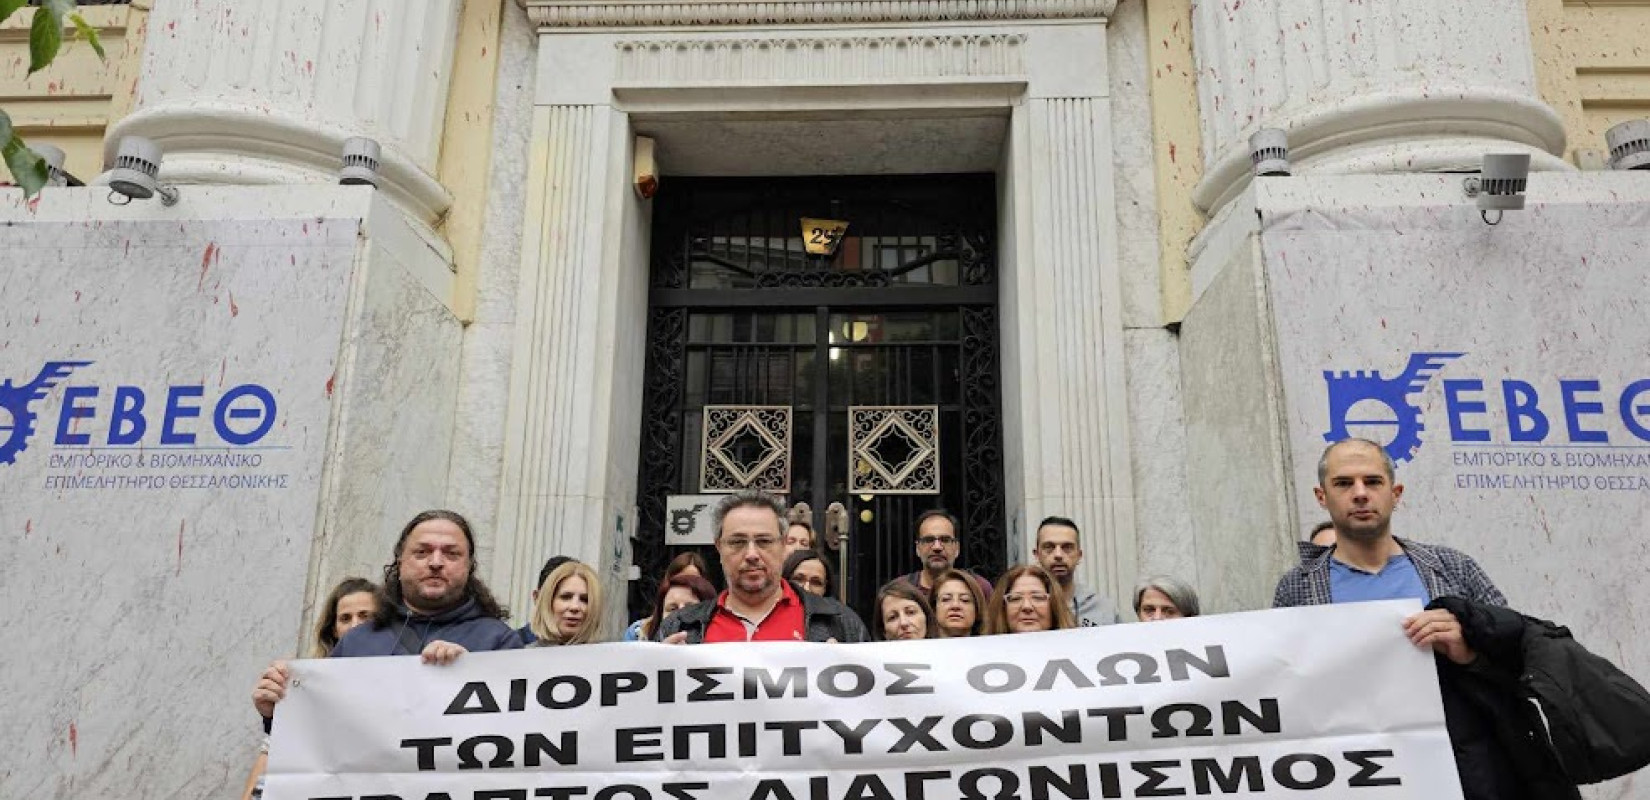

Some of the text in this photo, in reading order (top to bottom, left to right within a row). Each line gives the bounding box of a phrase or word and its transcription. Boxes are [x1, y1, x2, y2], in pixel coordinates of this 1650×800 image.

[54, 384, 277, 445] ΕΒΕΘ
[49, 454, 262, 468] ΕΜΠΟΡΙΚΟ & ΒΙΟΜΗΧΑΝΙΚΟ
[1453, 452, 1650, 468] ΕΜΠΟΡΙΚΟ & ΒΙΟΜΗΧΑ
[45, 474, 288, 489] ΕΠΙΜΕΛΗΤΗΡΙΟ ΘΕΣΣΑΛΟΝΙΚΗΣ
[1455, 474, 1590, 490] ΕΠΙΜΕΛΗΤΗΡΙΟ
[443, 644, 1231, 716] ΔΙΟΡΙΣΜΟΣ ΟΛΩΝ
[400, 698, 1283, 772] ΤΩΝ ΕΠΙΤΥΧΟΝΤΩΝ
